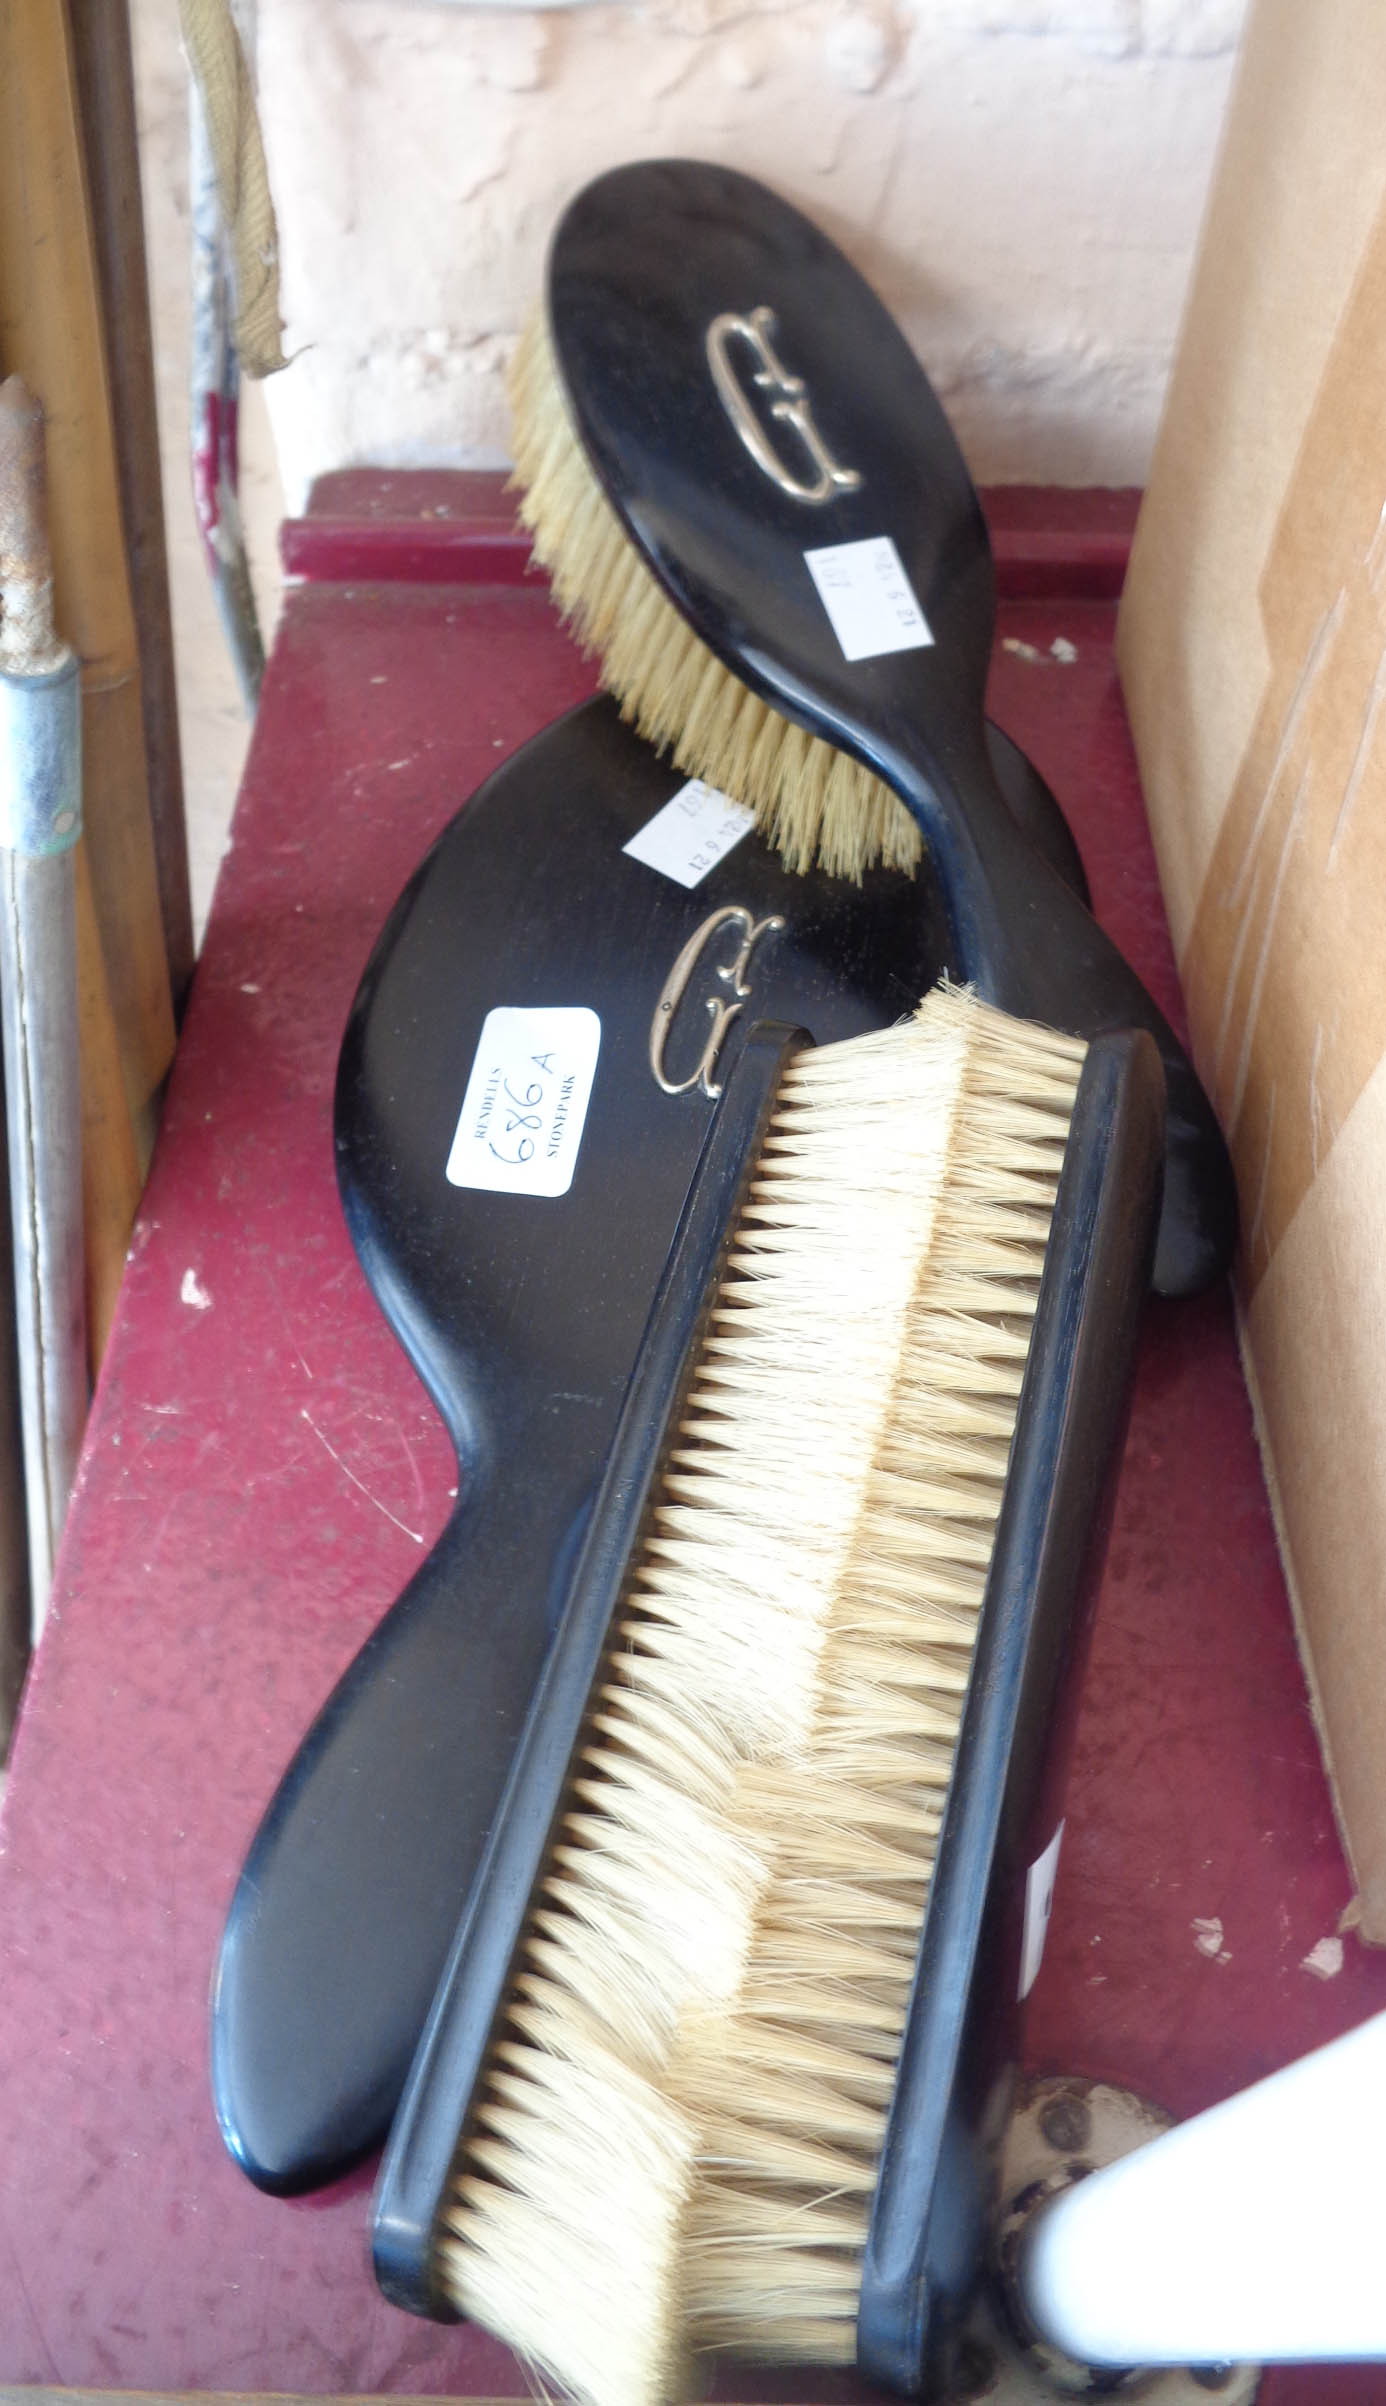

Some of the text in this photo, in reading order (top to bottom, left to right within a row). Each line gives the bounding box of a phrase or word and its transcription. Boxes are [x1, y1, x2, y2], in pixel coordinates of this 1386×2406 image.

[473, 1067, 501, 1139] RENDELLS
[488, 1053, 557, 1164] 686 A
[547, 1075, 576, 1158] STONEPARK
